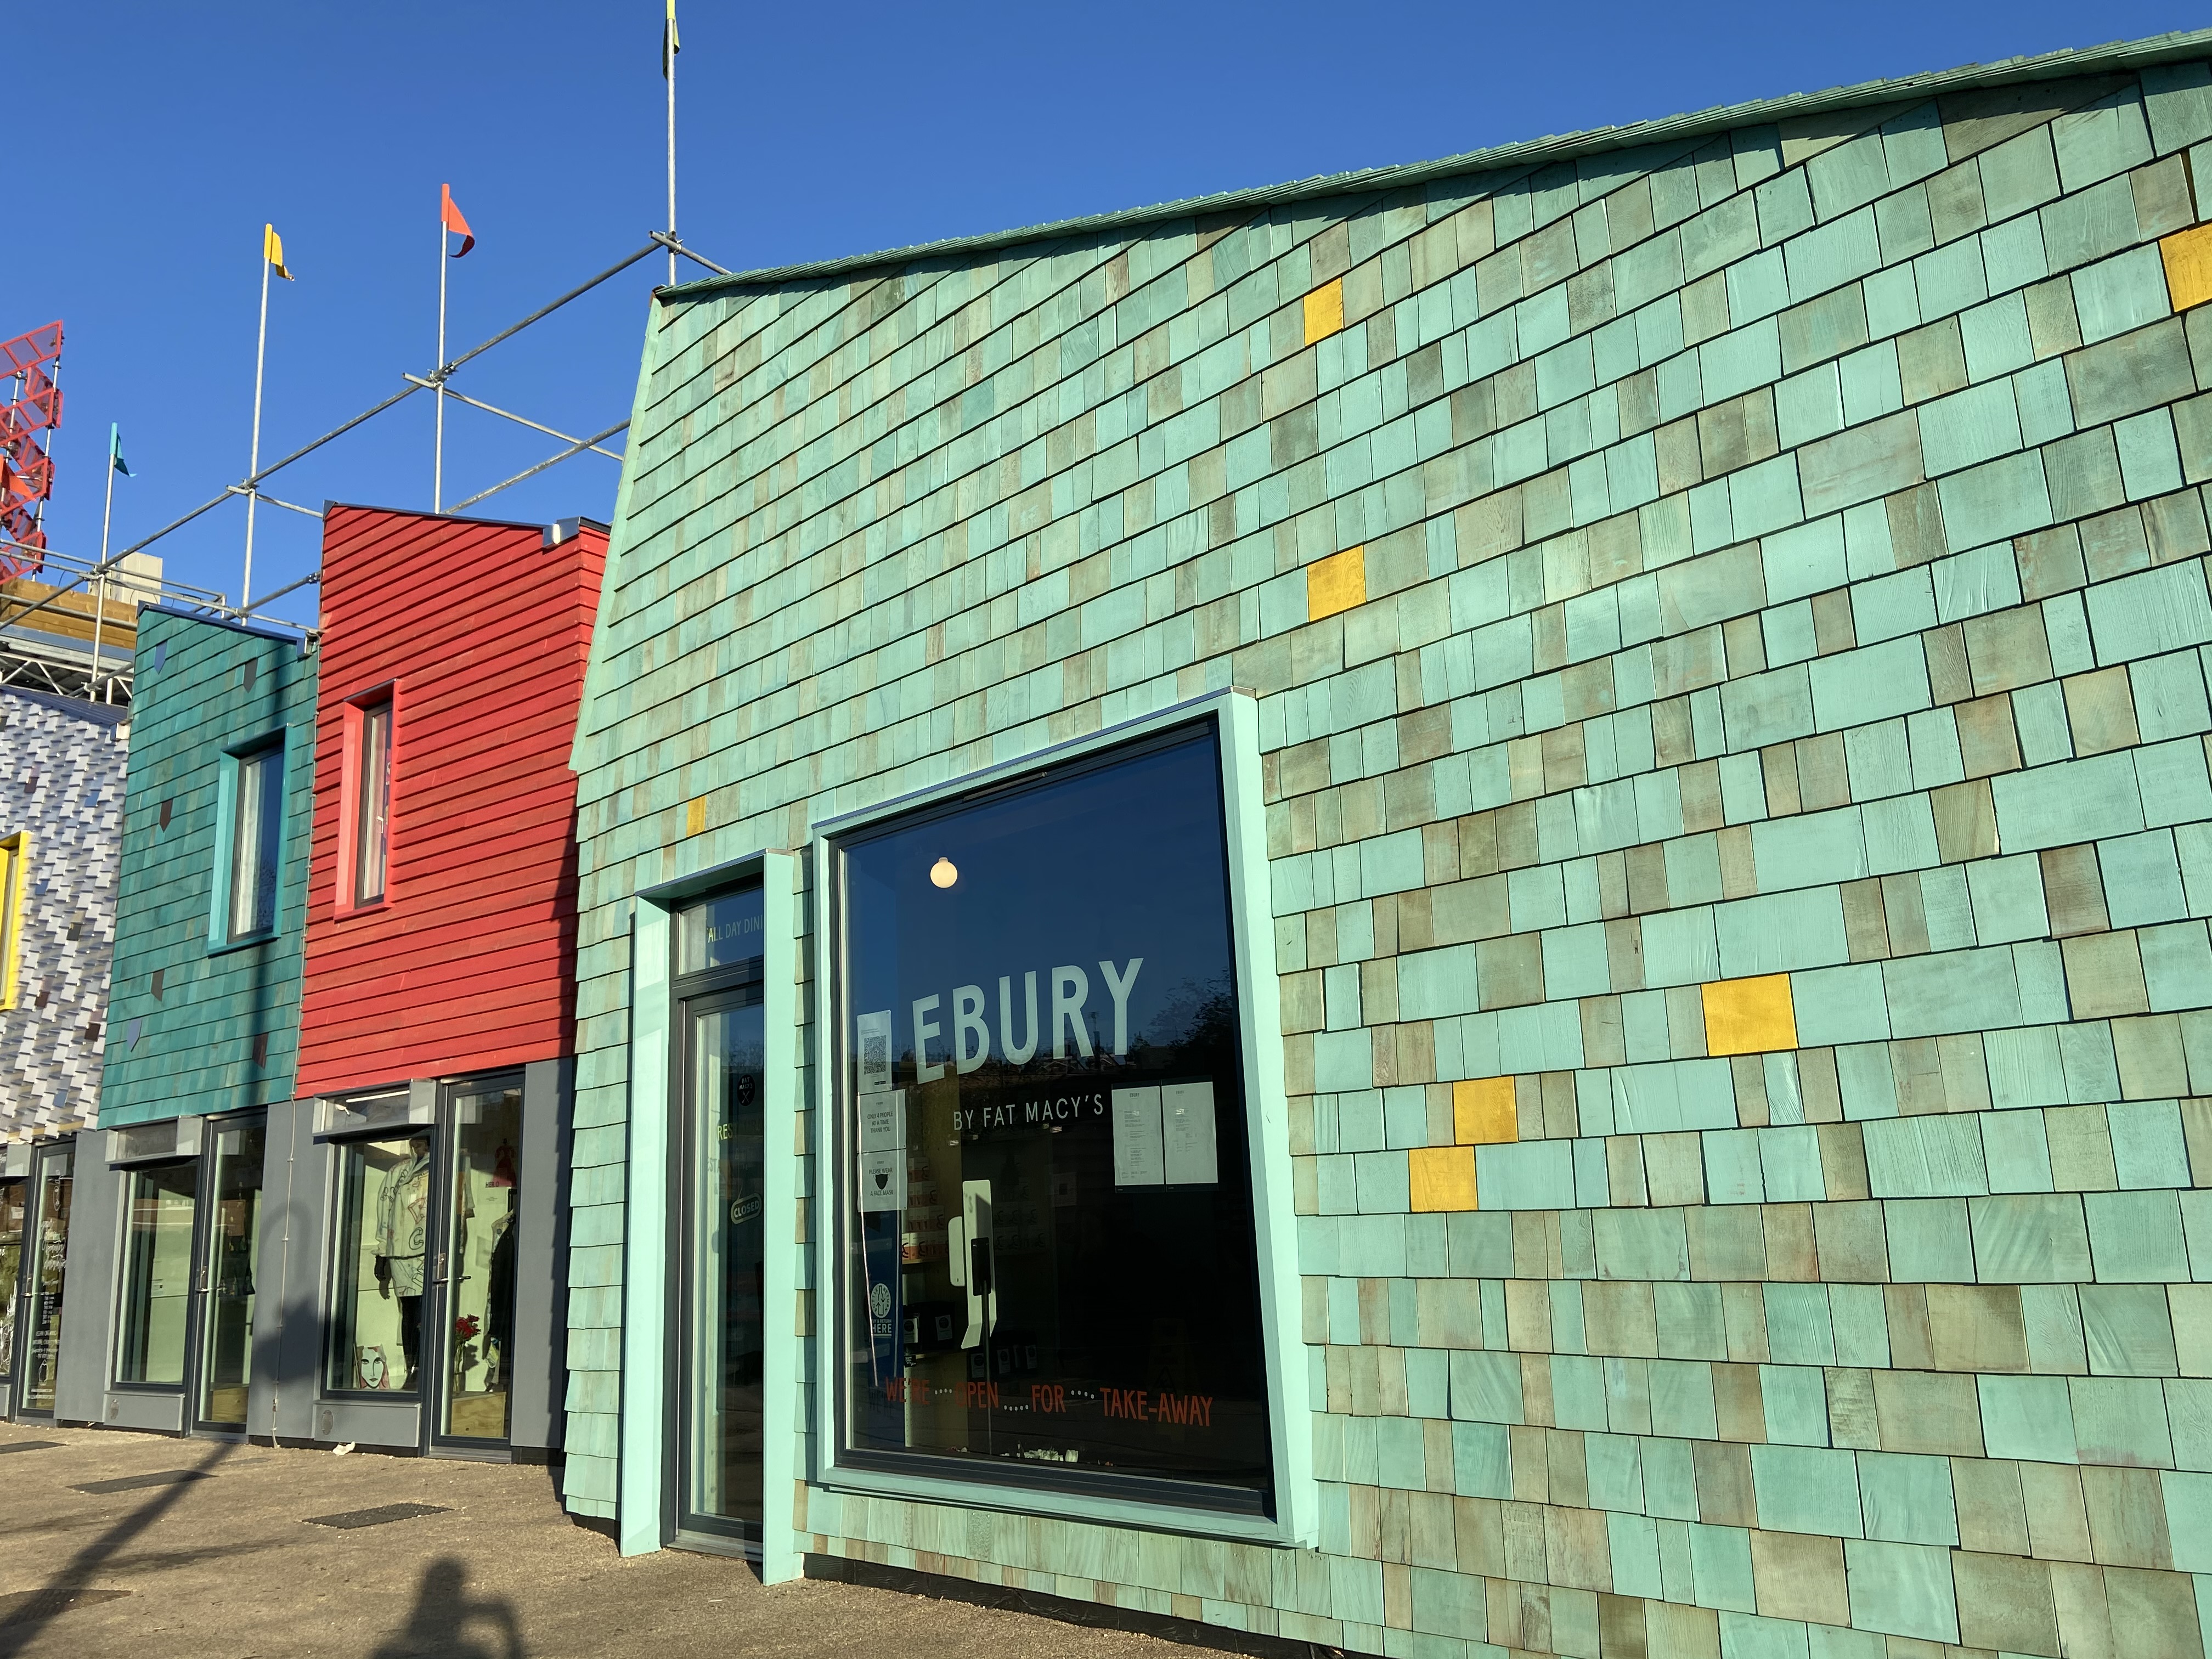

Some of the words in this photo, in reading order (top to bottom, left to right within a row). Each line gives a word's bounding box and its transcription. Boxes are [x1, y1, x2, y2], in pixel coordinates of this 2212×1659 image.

[708, 926, 723, 943] ALL
[725, 920, 742, 939] DAY
[912, 957, 1144, 1085] EBURY
[953, 1109, 974, 1131] BY
[983, 1104, 1015, 1127] FAT
[1025, 1094, 1103, 1123] MACY'S
[733, 1200, 760, 1218] CLOSED
[872, 1323, 892, 1333] HERE
[885, 1376, 930, 1405] WE'RE
[955, 1381, 1000, 1409] OPEN
[1031, 1385, 1066, 1414] FOR
[1099, 1387, 1213, 1427] TAKE-AWAY
